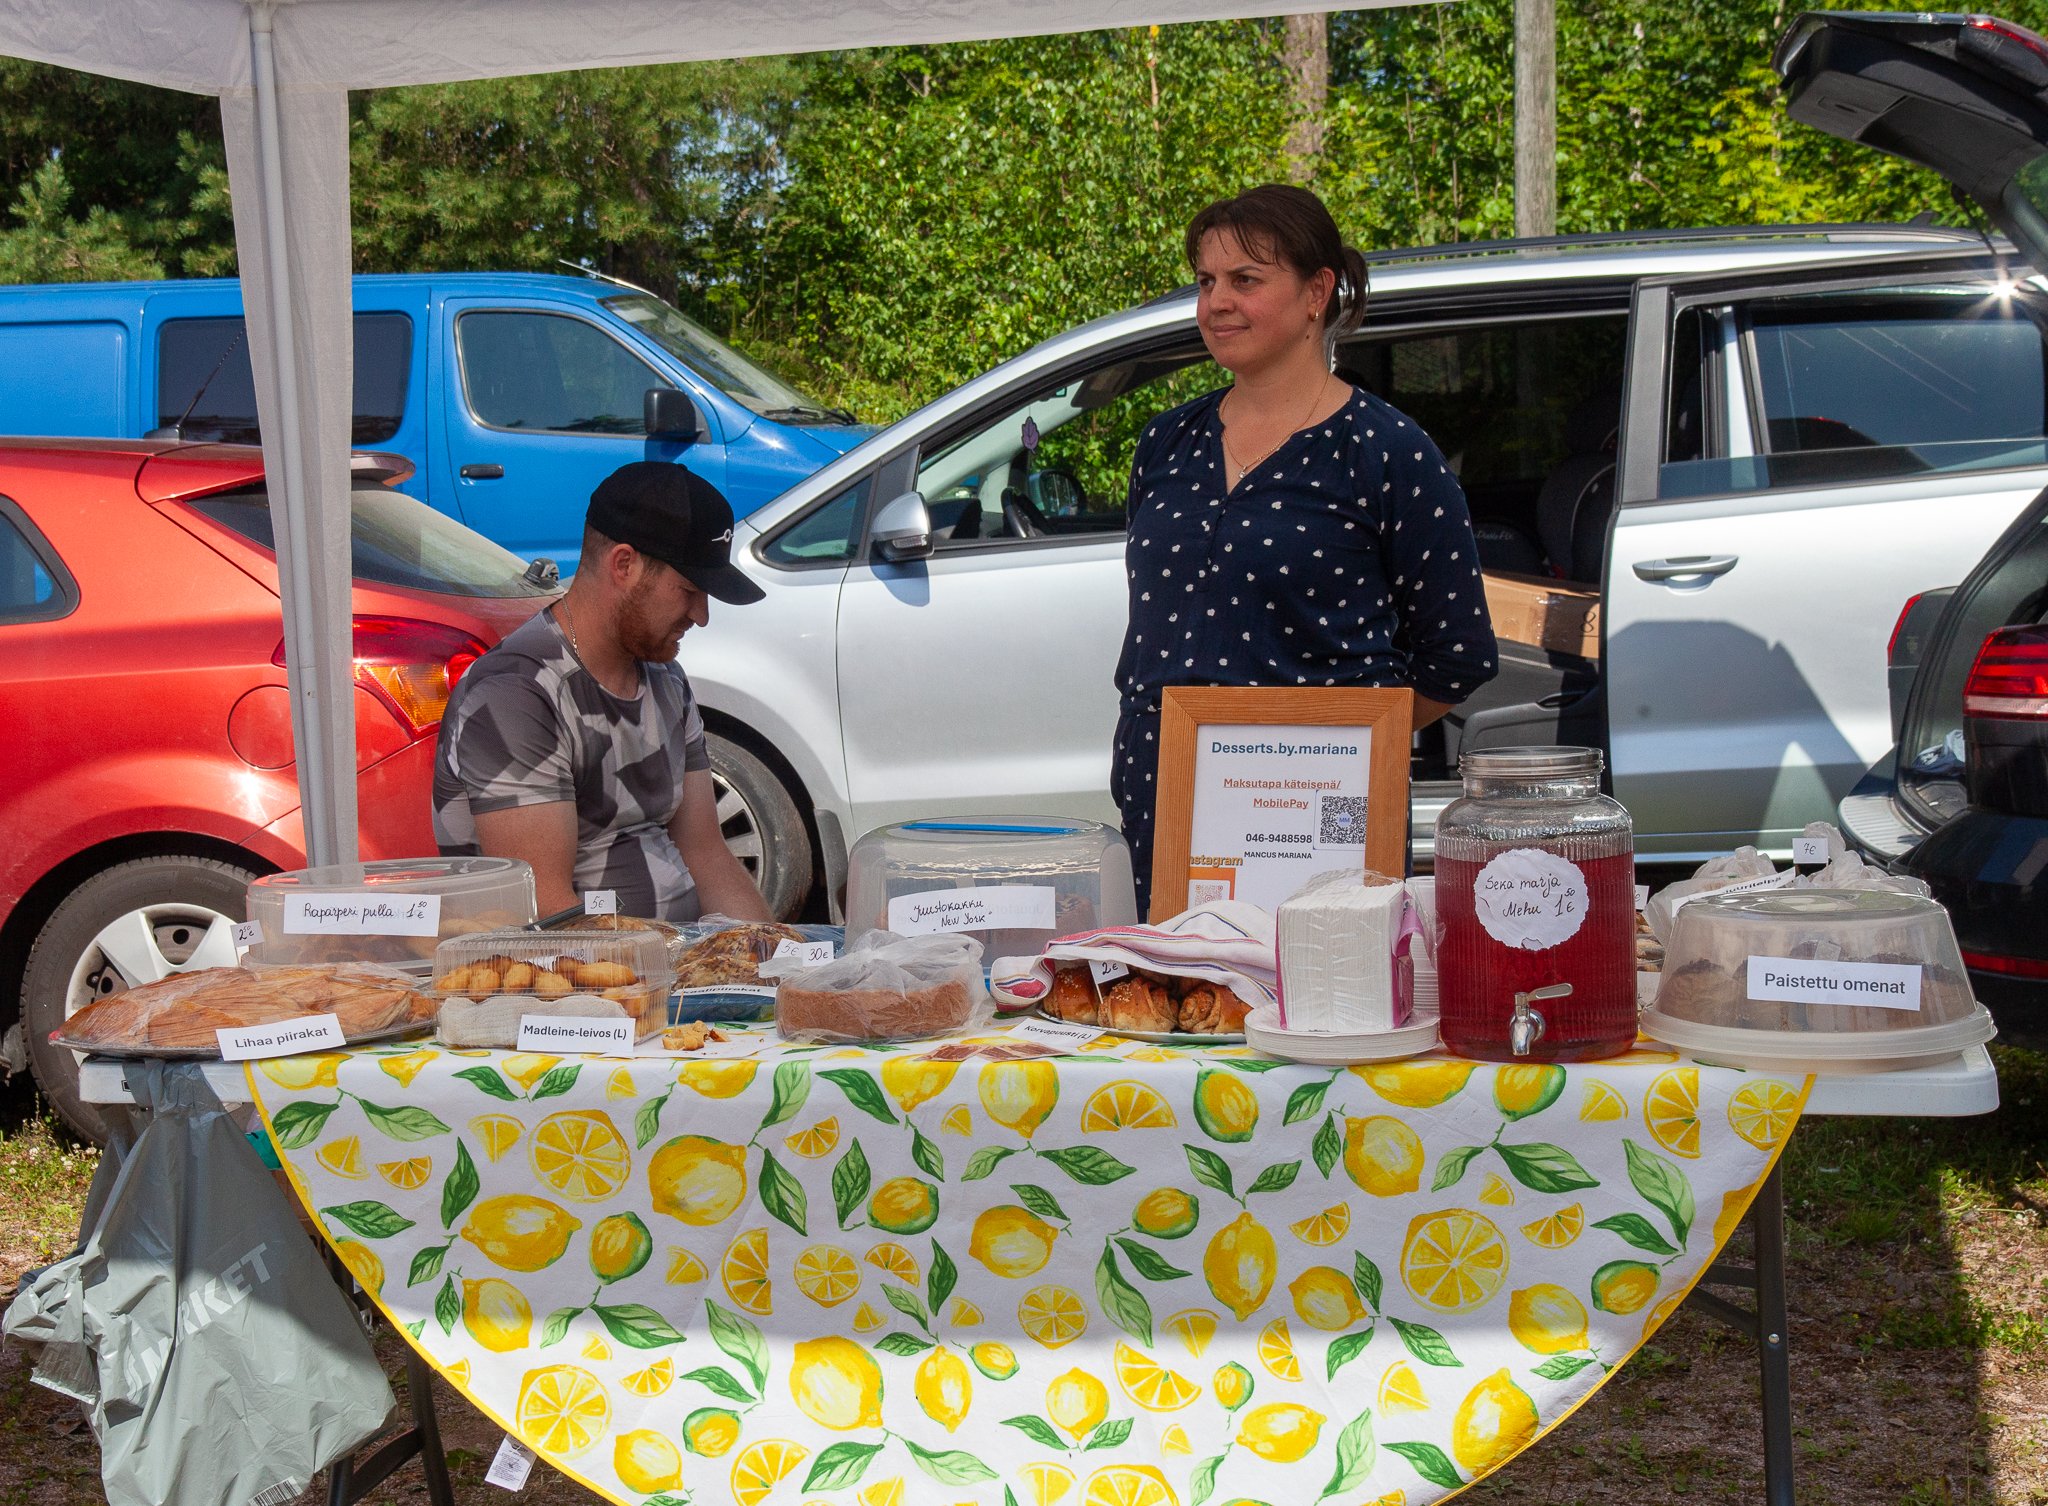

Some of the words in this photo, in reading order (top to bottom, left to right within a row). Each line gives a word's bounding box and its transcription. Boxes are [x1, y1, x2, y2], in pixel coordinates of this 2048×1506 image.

[1211, 742, 1358, 756] Desserts.by.mariana
[1223, 778, 1282, 789] Maksutapa
[1284, 779, 1341, 790] käteisenä/
[1253, 798, 1309, 810] MobilePay
[1245, 833, 1312, 843] 046-9488598
[1244, 851, 1277, 859] MANCUS
[590, 895, 605, 909] 5€
[1502, 901, 1542, 917] Mehu
[362, 904, 394, 924] pulla
[781, 942, 799, 956] 5€
[808, 947, 829, 961] 30€
[1101, 961, 1119, 975] 2€
[1765, 973, 1838, 990] Paistettu
[1843, 979, 1906, 994] omenat
[234, 1037, 273, 1049] Lihaa
[277, 1027, 329, 1046] piirakat
[523, 1025, 611, 1038] Madleine-leivos
[613, 1029, 627, 1040] (L)
[1024, 1025, 1079, 1038] Korvapuusti
